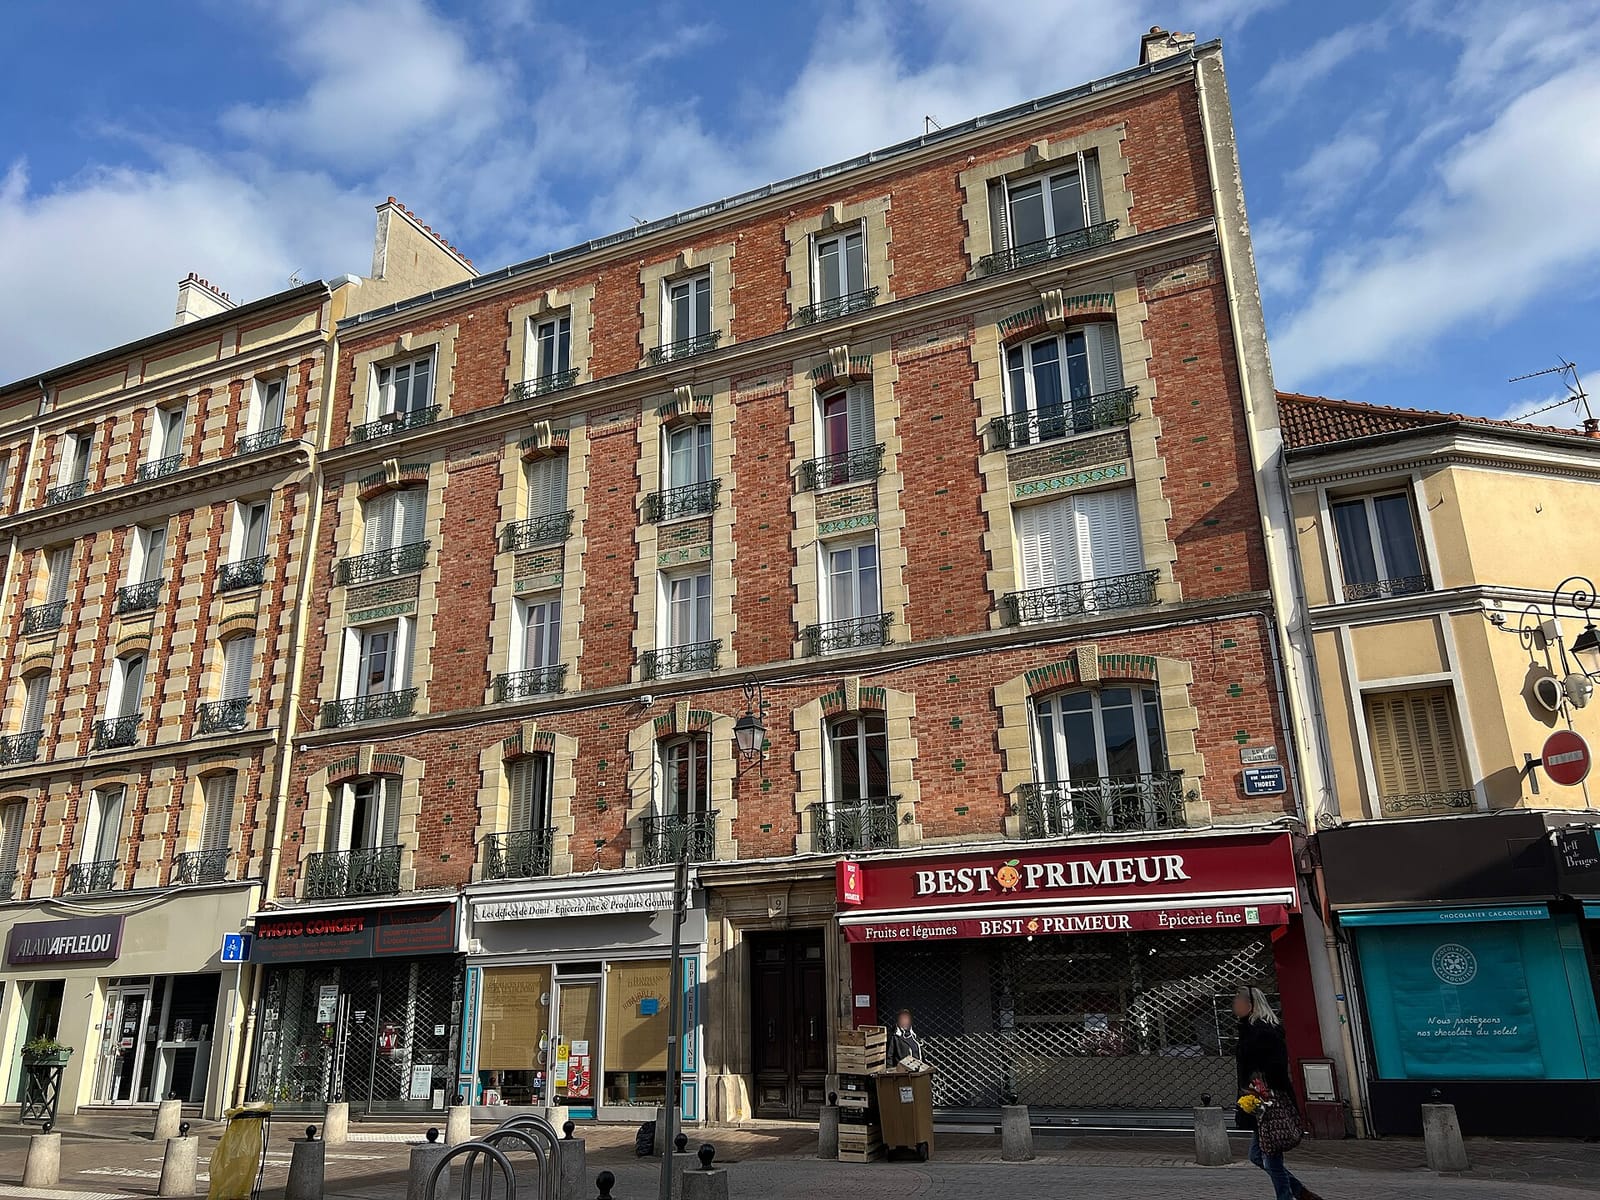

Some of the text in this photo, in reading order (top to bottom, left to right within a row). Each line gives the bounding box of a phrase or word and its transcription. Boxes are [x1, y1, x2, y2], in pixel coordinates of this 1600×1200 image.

[1563, 840, 1578, 853] Jeff
[1566, 856, 1598, 868] Bruges
[916, 855, 1191, 894] BEST PRIMEUR
[482, 910, 494, 918] Les
[519, 906, 527, 916] de
[586, 902, 599, 912] fine
[601, 902, 609, 910] &
[611, 900, 643, 910] Produits
[776, 900, 782, 910] 2
[980, 915, 1132, 935] BEST PRIMEUR
[1158, 911, 1241, 928] Épicerie fine
[258, 921, 303, 938] PHOTO
[306, 917, 365, 934] CONCEPT
[866, 925, 958, 938] Fruits et légumes
[16, 934, 111, 956] ALAIN AFFLELOU
[1428, 1016, 1500, 1028] Nous protégeons
[1435, 1026, 1472, 1036] chocolats
[1493, 1026, 1518, 1034] soleil
